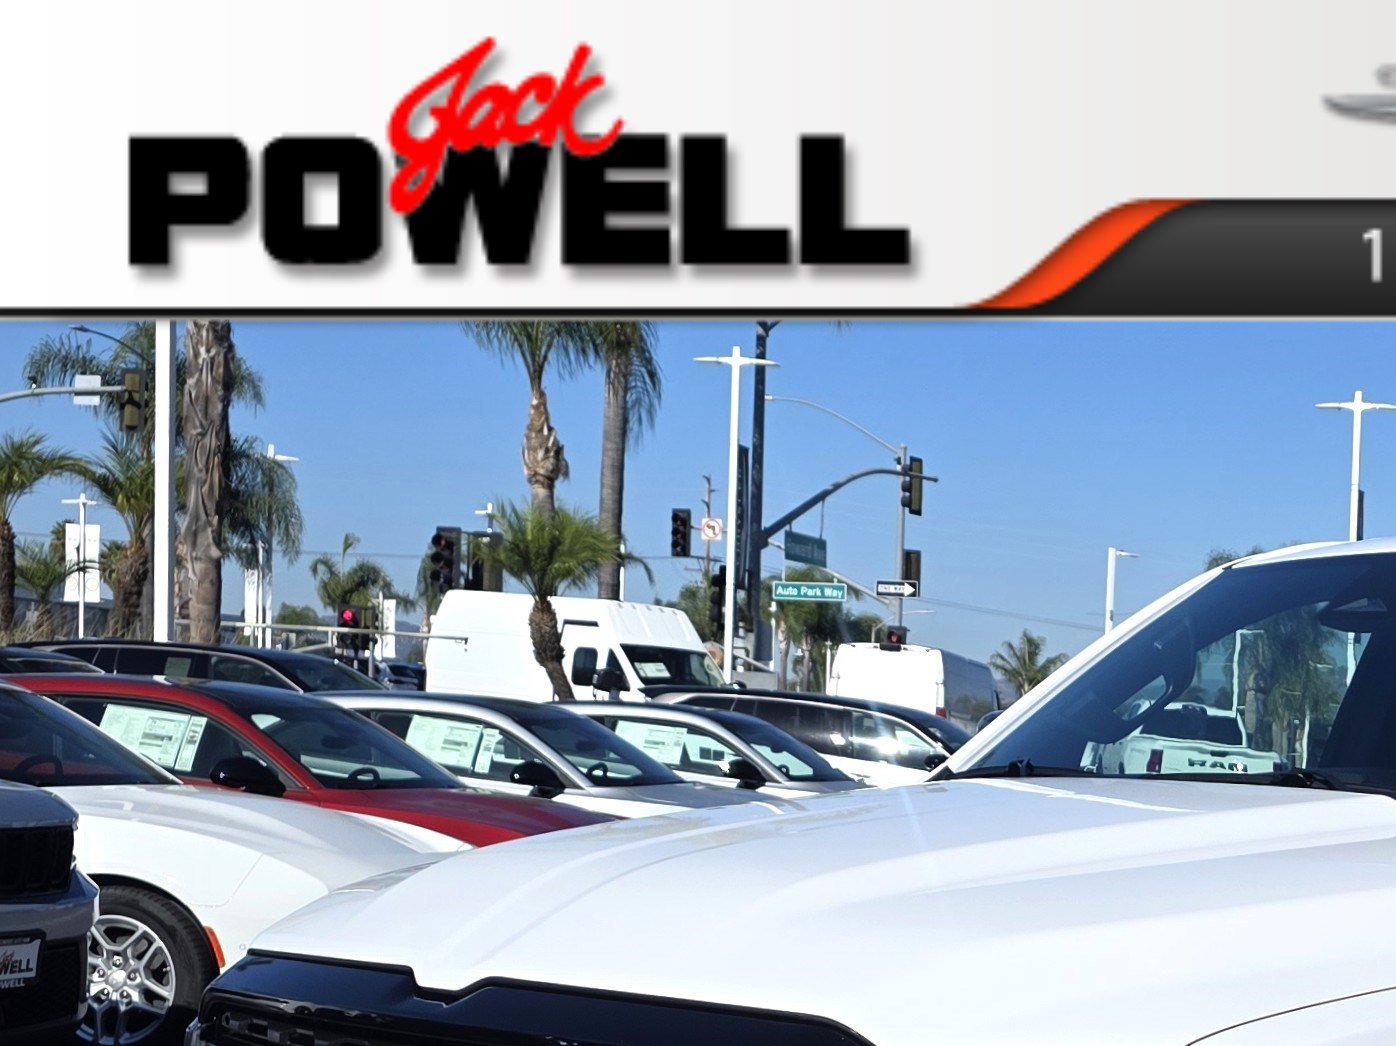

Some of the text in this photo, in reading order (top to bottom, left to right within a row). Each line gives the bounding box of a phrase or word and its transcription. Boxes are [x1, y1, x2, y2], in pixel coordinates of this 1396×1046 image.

[776, 585, 843, 599] Auto Park Way
